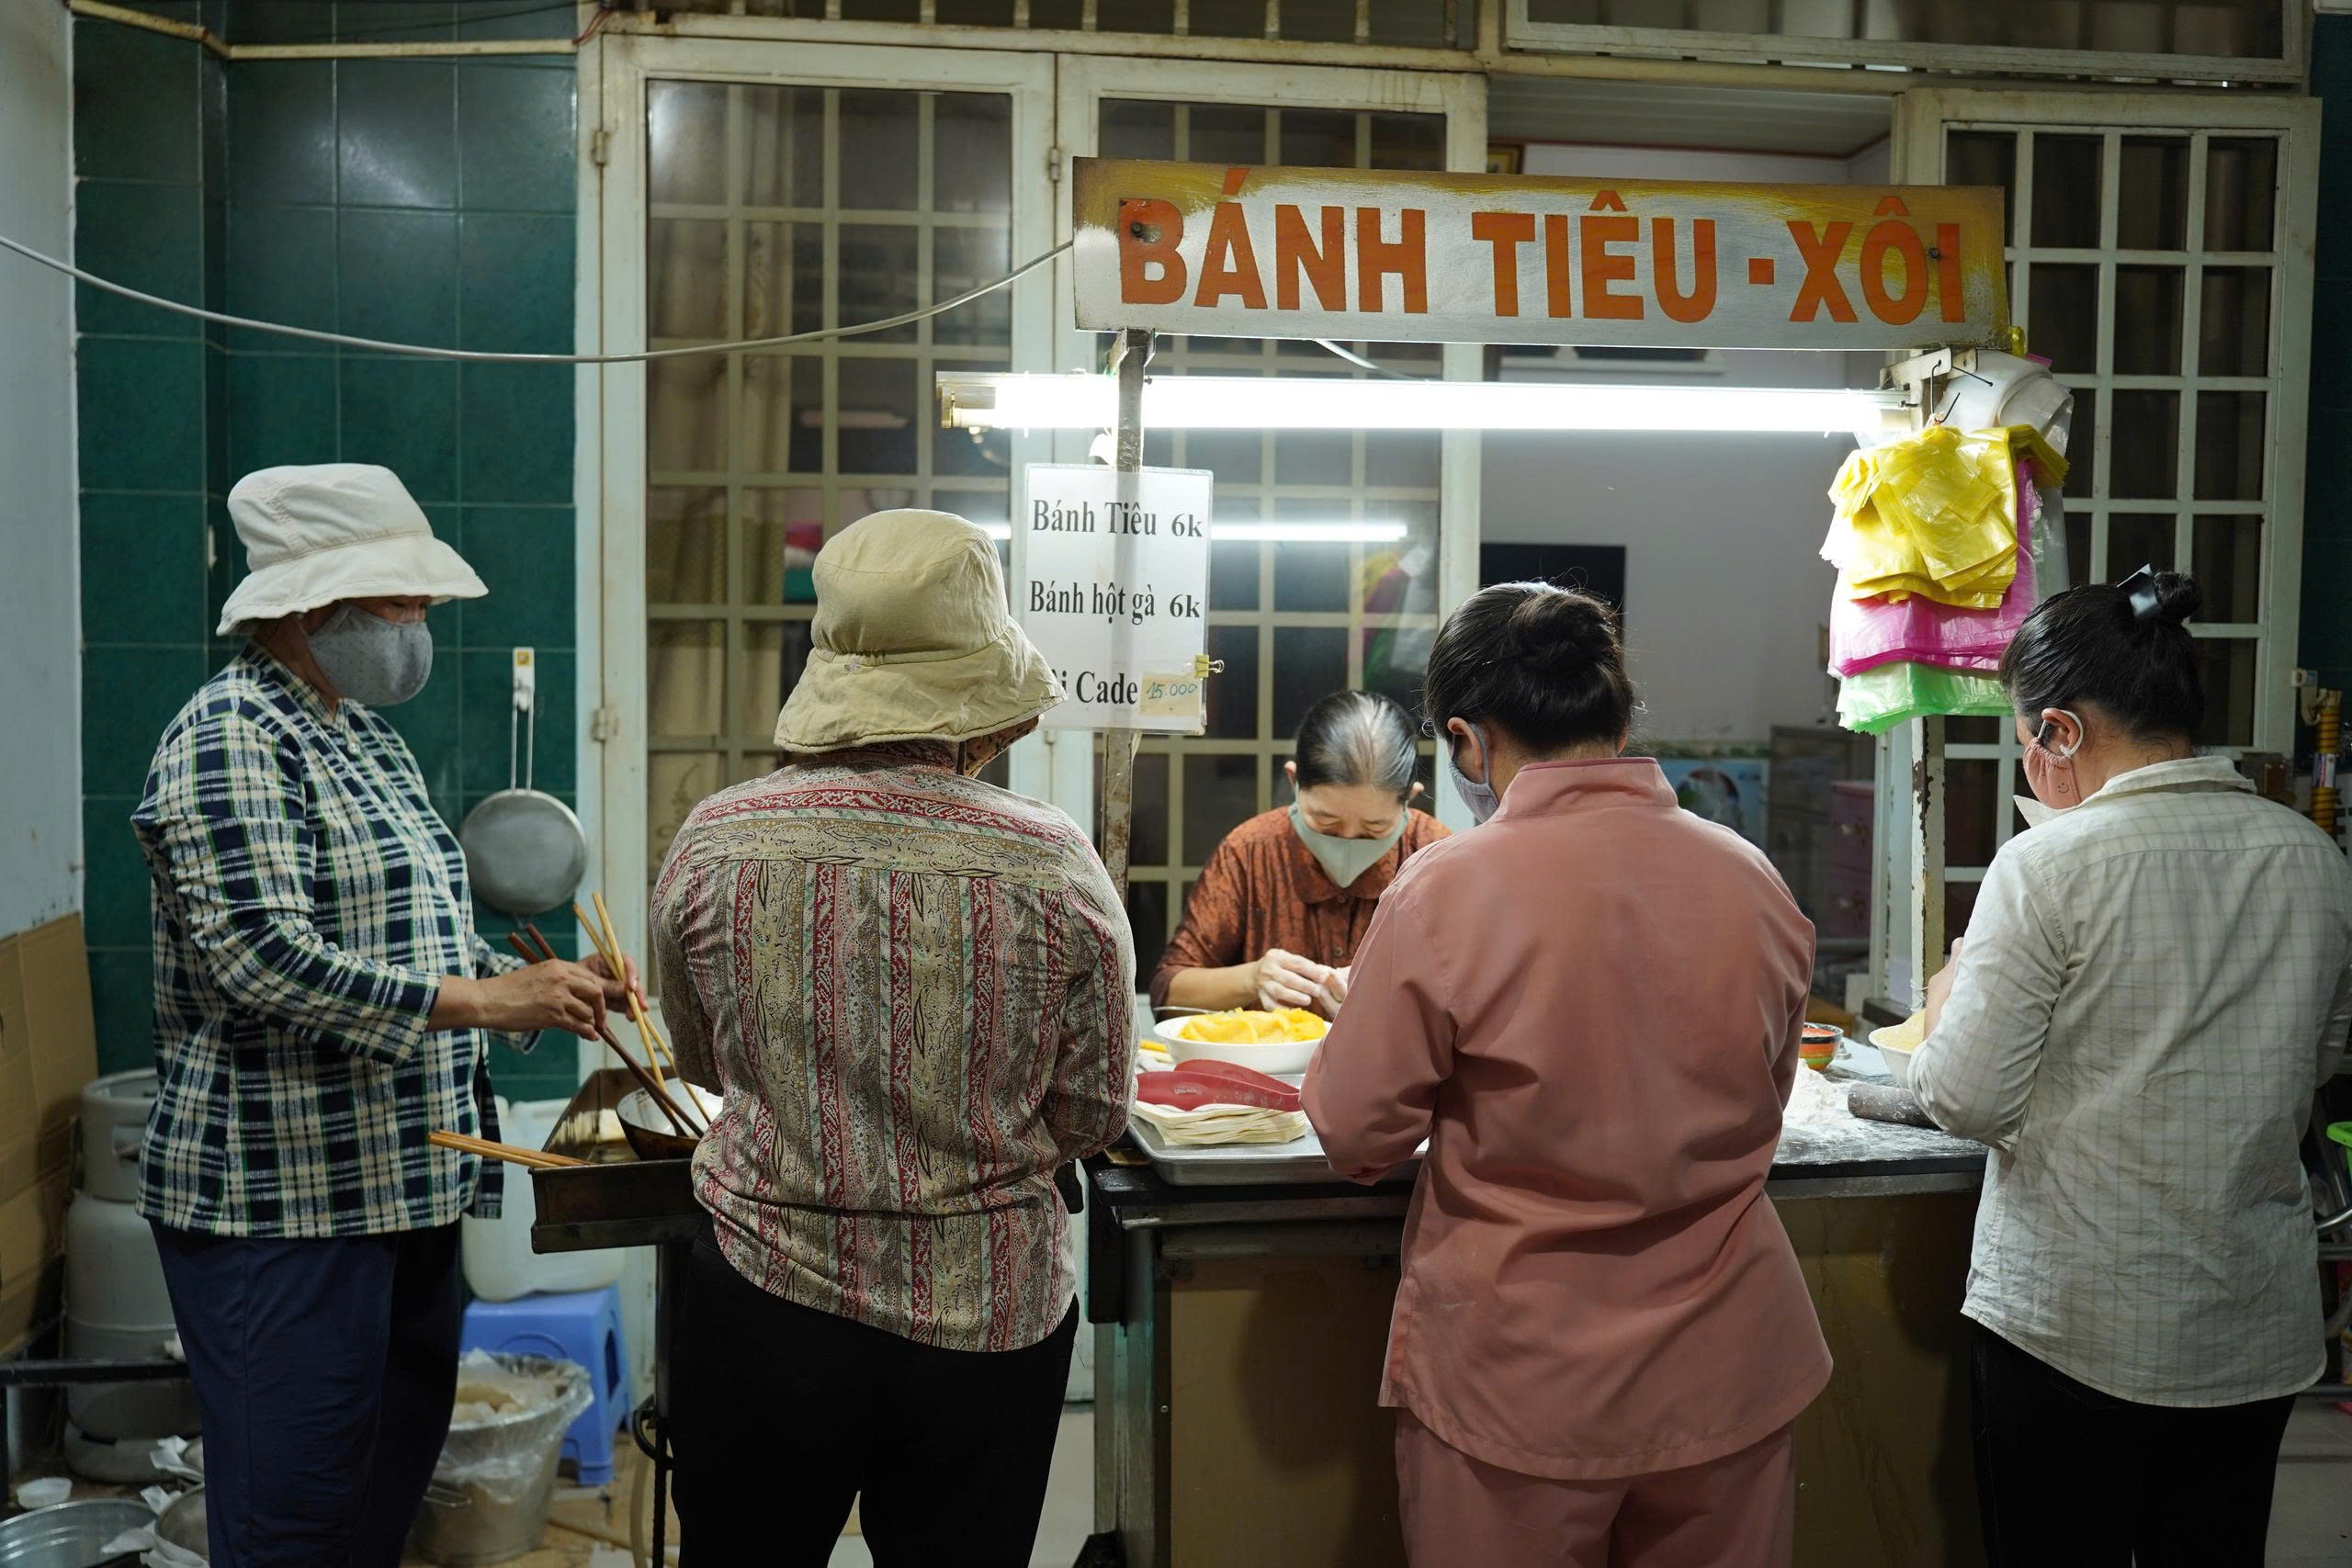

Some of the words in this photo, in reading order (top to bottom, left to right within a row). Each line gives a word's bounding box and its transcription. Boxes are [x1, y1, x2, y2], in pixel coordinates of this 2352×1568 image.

[1119, 167, 1429, 314] BÁNH
[1471, 189, 1717, 324] TIÊU
[1787, 197, 1964, 326] XÔI
[1033, 500, 1095, 533] Bánh
[1104, 502, 1157, 536] Tiêu
[1171, 513, 1203, 537] 6k
[1029, 581, 1084, 614] Bánh
[1091, 582, 1126, 625] hột
[1131, 584, 1155, 626] gà
[1169, 594, 1200, 618] 6k
[1076, 671, 1138, 705] Cade
[1146, 681, 1197, 701] 15.000
